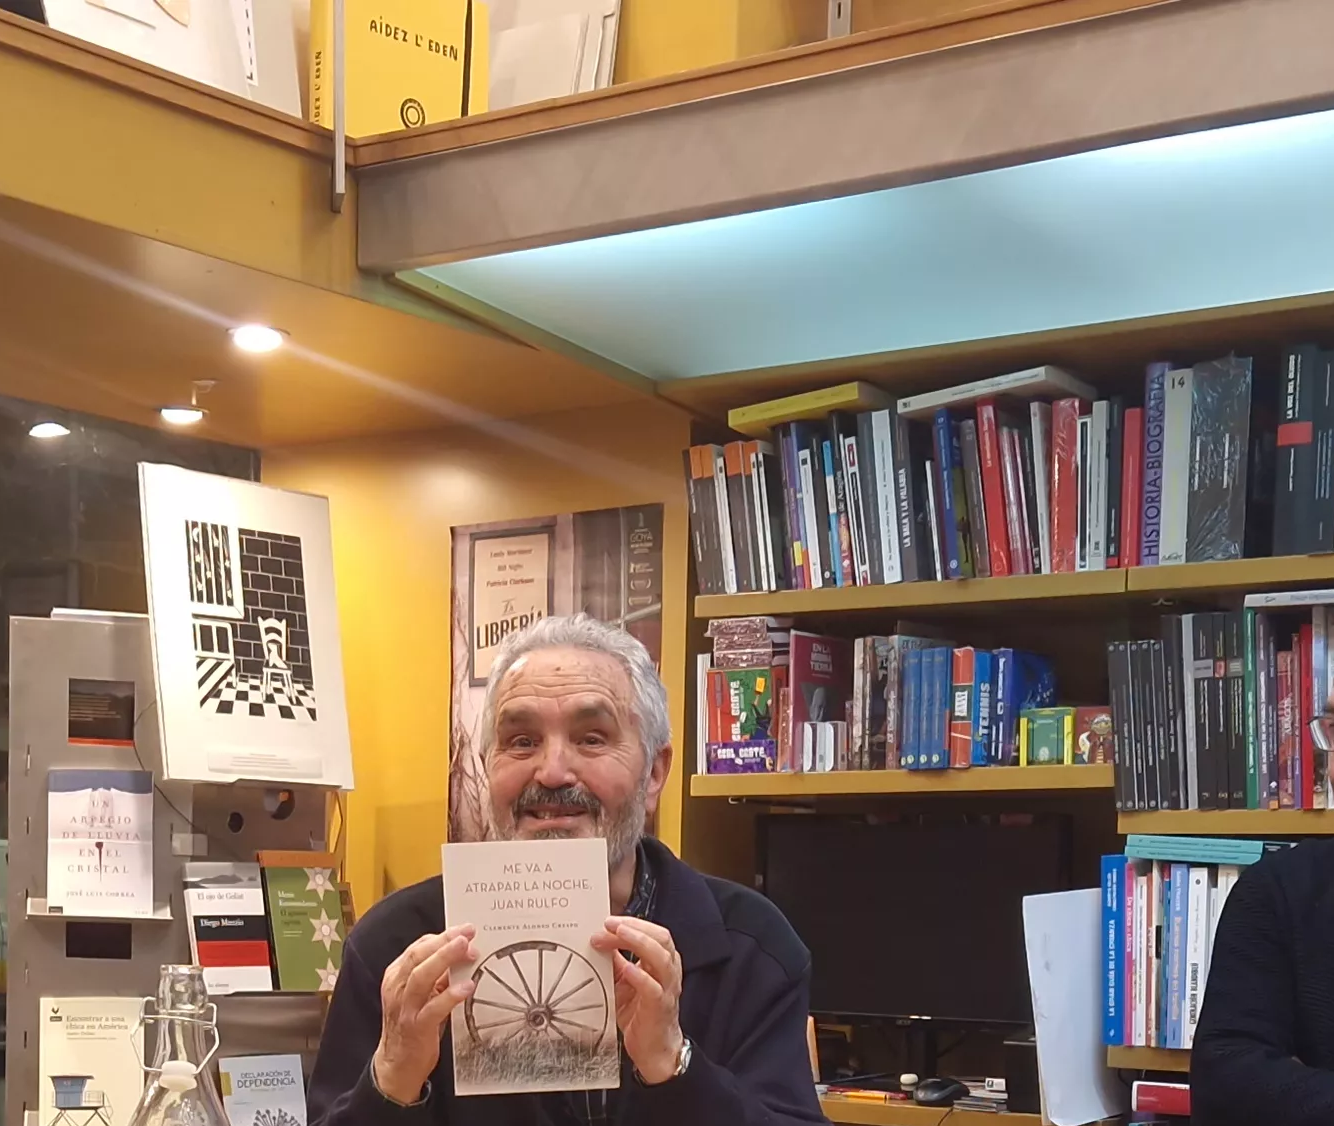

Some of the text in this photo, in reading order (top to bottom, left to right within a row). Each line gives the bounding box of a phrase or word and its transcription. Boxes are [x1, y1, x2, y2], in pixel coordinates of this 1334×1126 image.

[428, 39, 458, 62] EDEN
[487, 579, 507, 588] Patricia
[978, 682, 990, 736] TENNIS
[92, 800, 110, 808] UN
[70, 815, 132, 825] ARPEGIO
[62, 831, 141, 840] DE LLUVIA
[79, 848, 122, 858] EN EL
[67, 864, 129, 874] CRISTAL
[503, 863, 552, 874] ME VA A
[465, 879, 592, 893] ATRAPAR LA NOCHE,
[491, 898, 568, 910] JUAN RULFO
[200, 919, 220, 928] Diego
[66, 1014, 104, 1023] Encontrar
[97, 1022, 128, 1031] América
[240, 1069, 292, 1080] DECLARACIÓN DE
[237, 1077, 296, 1089] DEPENDENCIA
